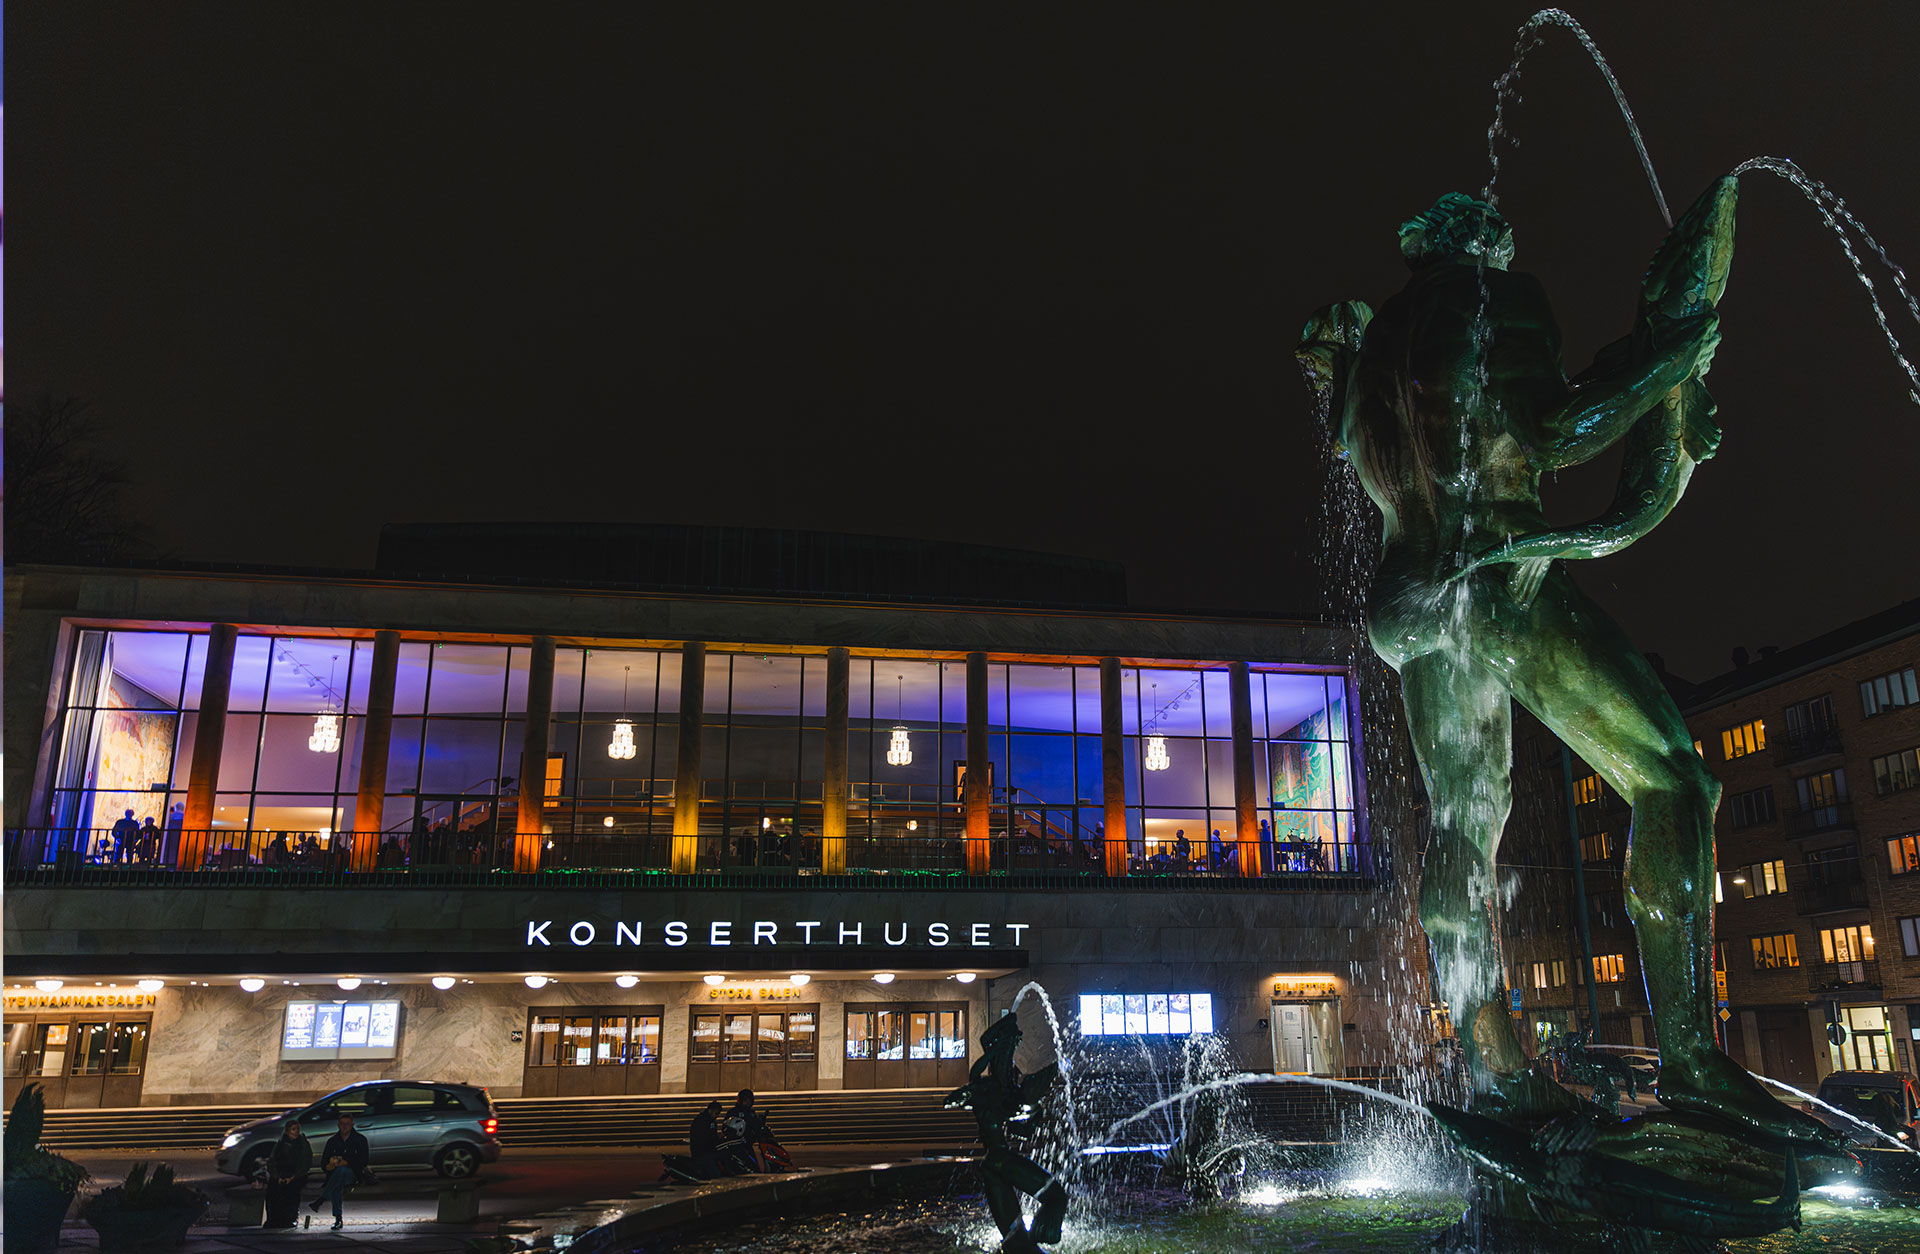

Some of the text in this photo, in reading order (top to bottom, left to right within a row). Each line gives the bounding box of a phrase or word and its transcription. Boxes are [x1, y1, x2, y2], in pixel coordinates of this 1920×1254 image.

[527, 920, 1030, 947] KONSERTHUSET
[1275, 982, 1336, 993] BILJETTER
[710, 988, 801, 999] STORA SALEN
